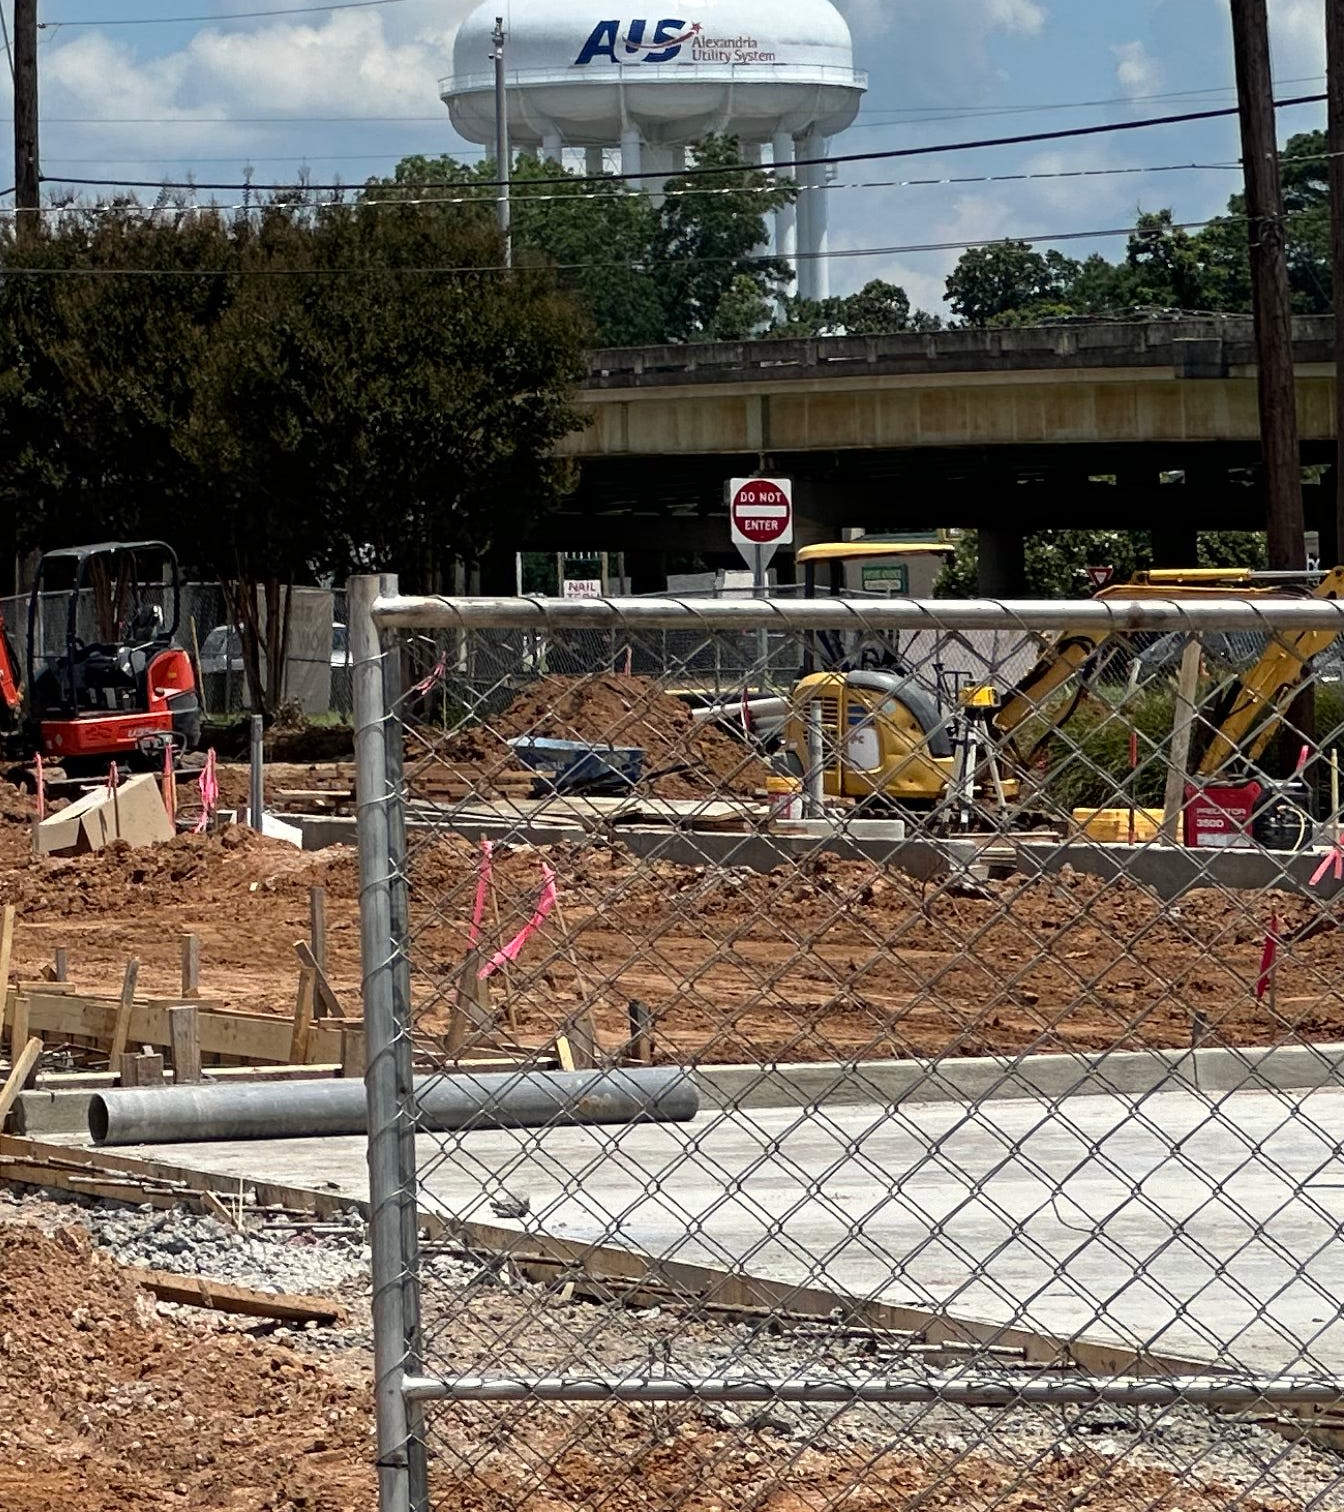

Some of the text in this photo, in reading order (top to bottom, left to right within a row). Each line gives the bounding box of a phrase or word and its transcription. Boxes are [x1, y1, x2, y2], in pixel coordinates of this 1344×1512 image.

[691, 35, 758, 49] Alexandria
[691, 49, 776, 64] Utility System
[739, 491, 782, 503] DO NOT
[744, 519, 779, 531] ENTER
[568, 582, 596, 592] NAIL
